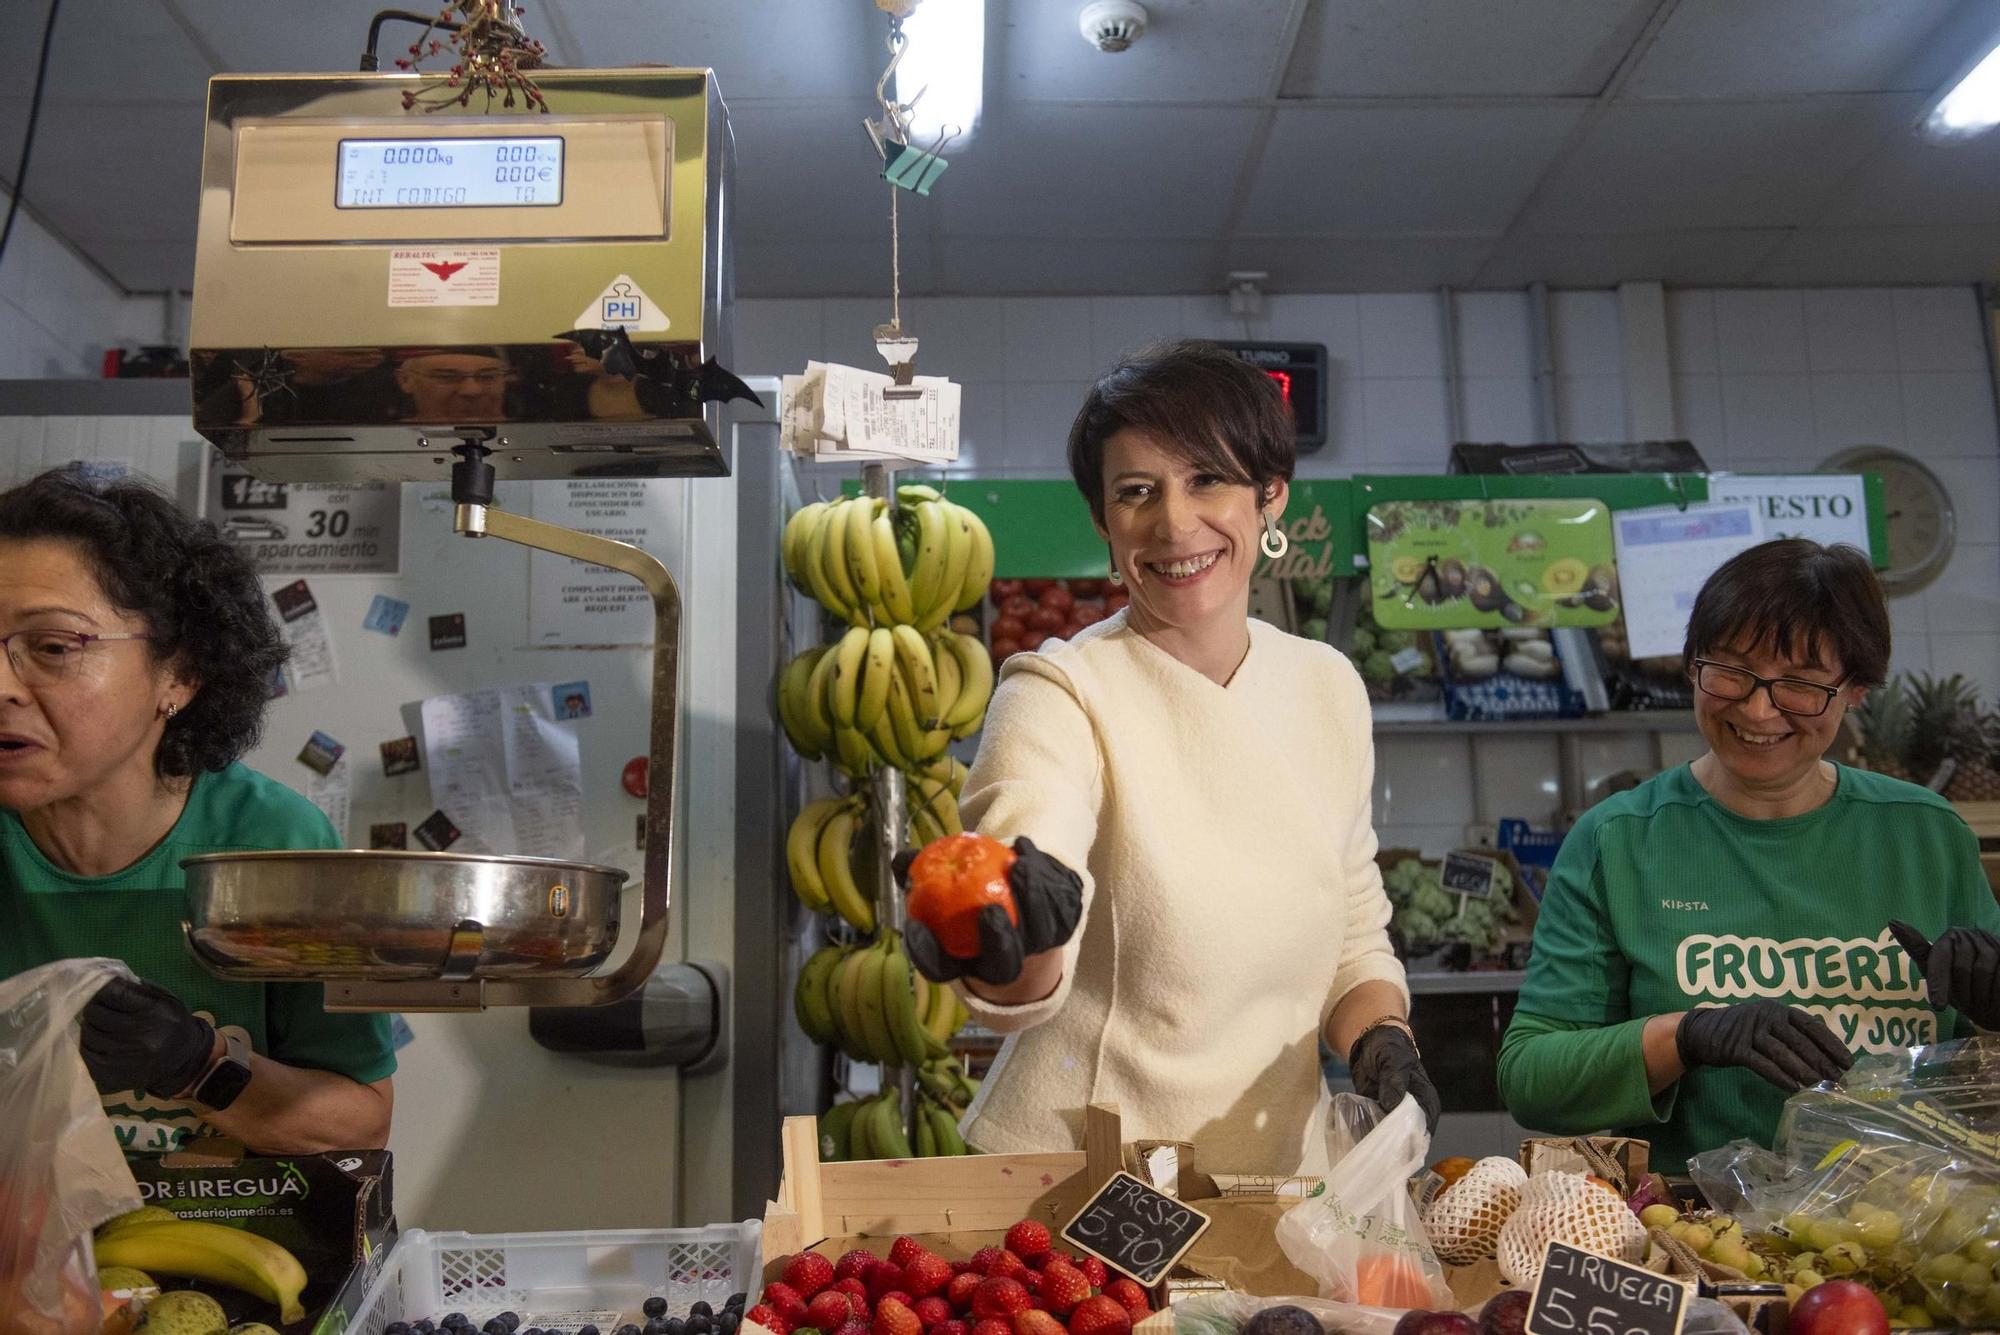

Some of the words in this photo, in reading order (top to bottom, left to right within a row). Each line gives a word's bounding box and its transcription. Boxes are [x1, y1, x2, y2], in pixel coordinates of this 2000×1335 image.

[352, 188, 385, 205] INT
[607, 302, 635, 318] PH
[305, 509, 350, 539] 30
[256, 541, 379, 560] aparcamiento
[584, 604, 627, 614] REQUEST
[1662, 899, 1709, 911] KIPSTA
[1840, 1012, 1859, 1044] Y
[1867, 1015, 1932, 1047] JOSE
[178, 1180, 187, 1198] DEL
[190, 1176, 302, 1199] IREGUA
[173, 1206, 294, 1220] rasderiojamedia.es
[1107, 1177, 1191, 1237] FRESA
[1547, 1248, 1675, 1313] CIRUELA
